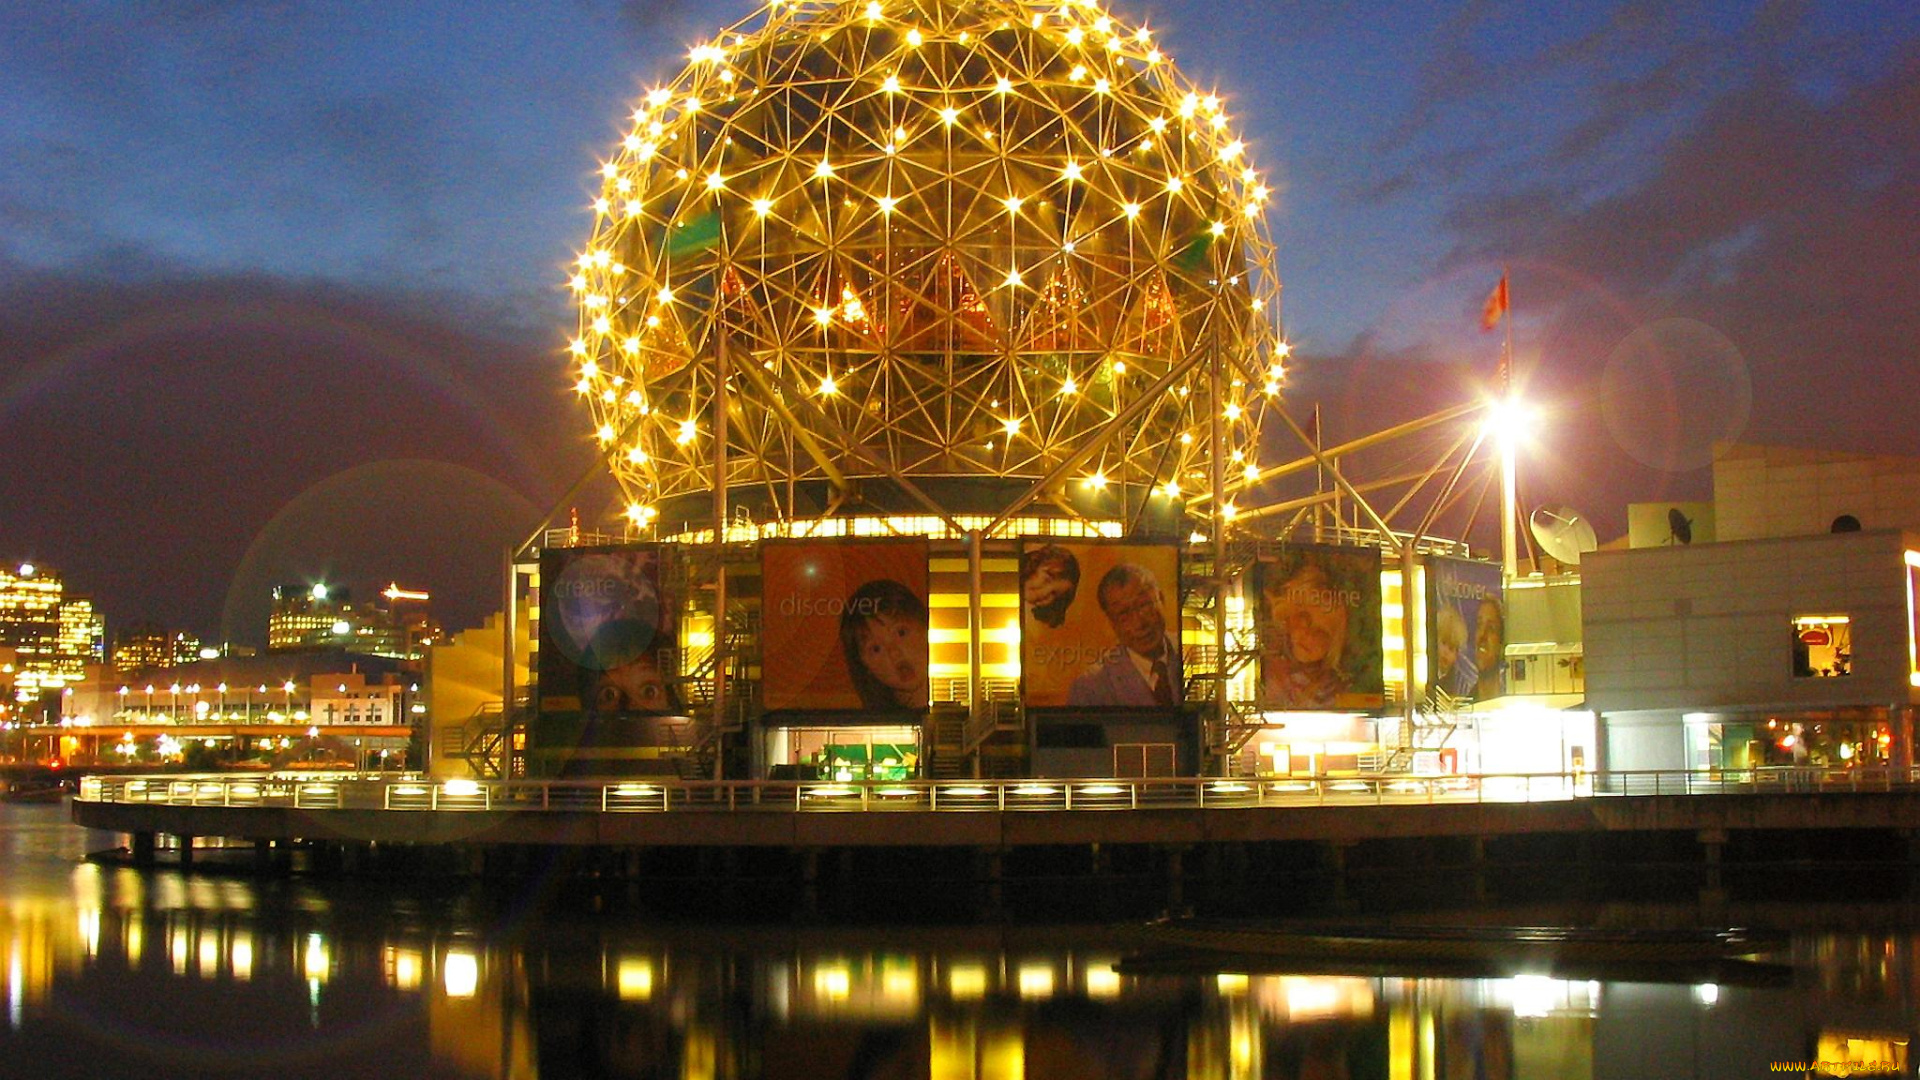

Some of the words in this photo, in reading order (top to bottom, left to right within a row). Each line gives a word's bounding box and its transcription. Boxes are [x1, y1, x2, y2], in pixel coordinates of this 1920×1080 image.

[1285, 583, 1360, 613] imagine
[1441, 577, 1486, 600] scover
[780, 593, 882, 616] discover
[1033, 643, 1126, 671] explore
